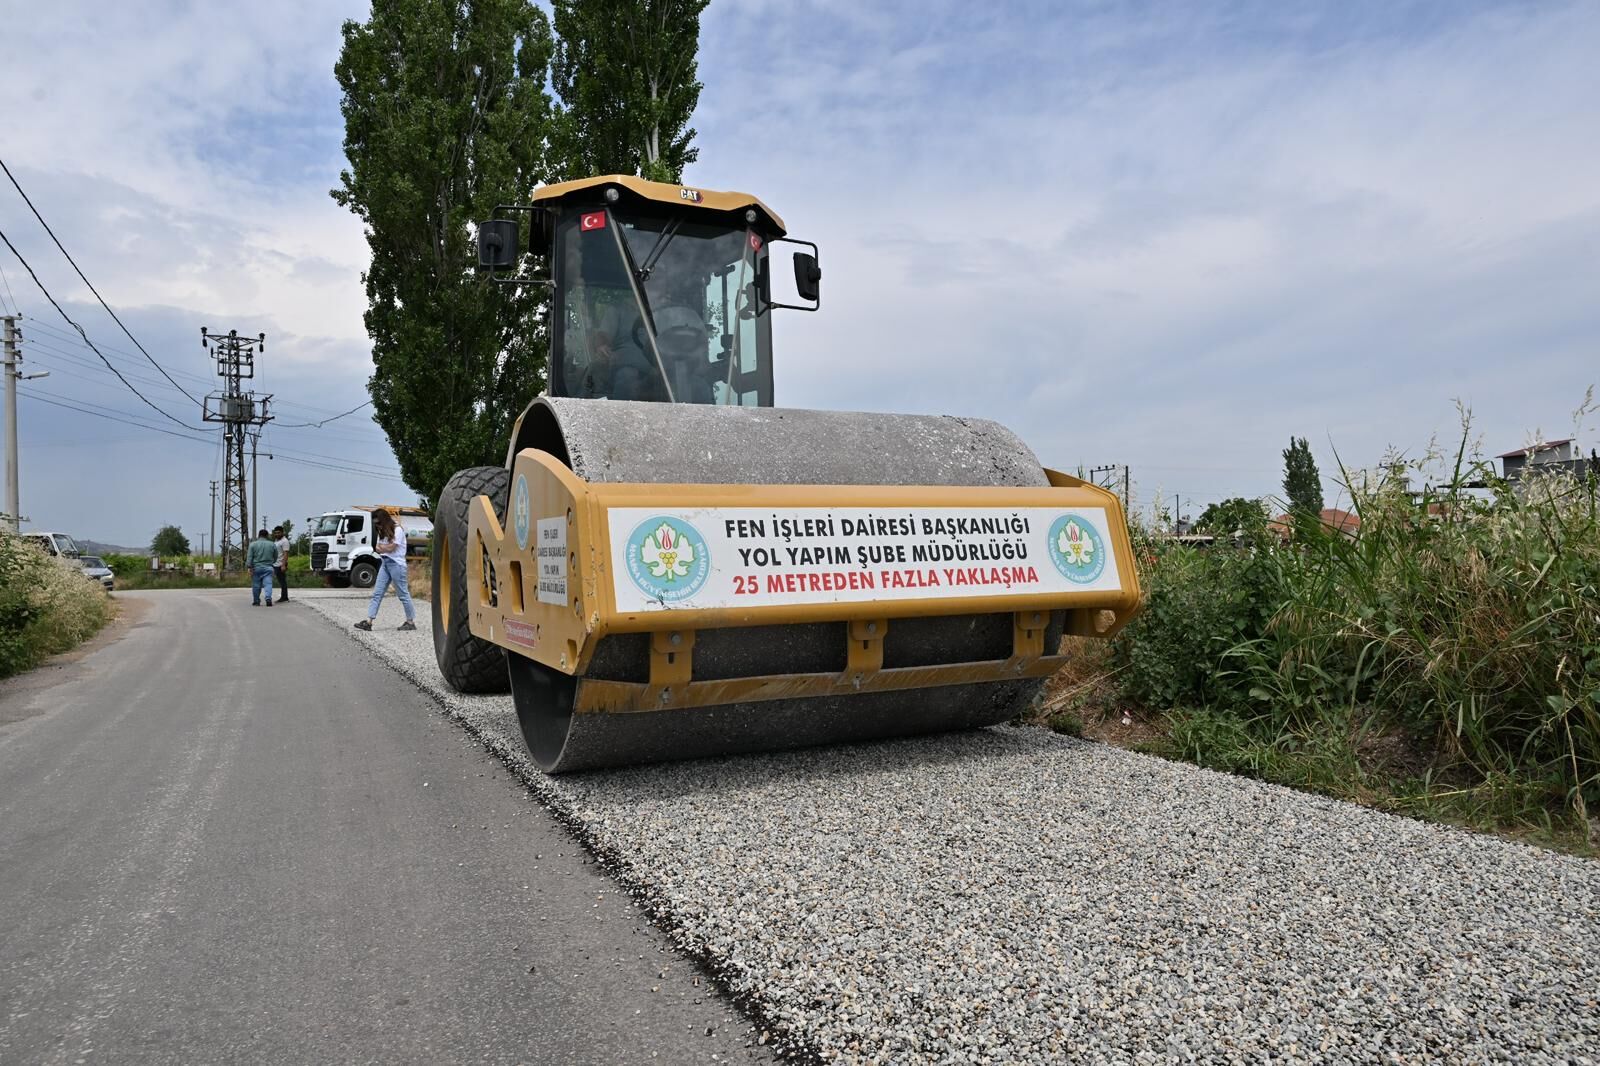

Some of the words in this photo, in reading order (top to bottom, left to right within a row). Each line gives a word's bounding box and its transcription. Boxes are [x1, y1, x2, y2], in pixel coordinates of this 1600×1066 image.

[680, 189, 698, 201] CAT
[725, 519, 766, 538] FEN
[772, 513, 835, 543] İŞLERİ
[841, 513, 916, 537] DAİRESİ
[922, 512, 1030, 540] BAŞKANLIĞI
[738, 547, 782, 567] YOL
[785, 546, 852, 566] YAPIM
[857, 545, 906, 569] ŞUBE
[912, 538, 1028, 562] MÜDÜRLÜĞÜ
[732, 575, 759, 595] 25
[767, 571, 875, 594] METREDEN
[881, 569, 940, 589] FAZLA
[943, 566, 1039, 589] YAKLAŞMA
